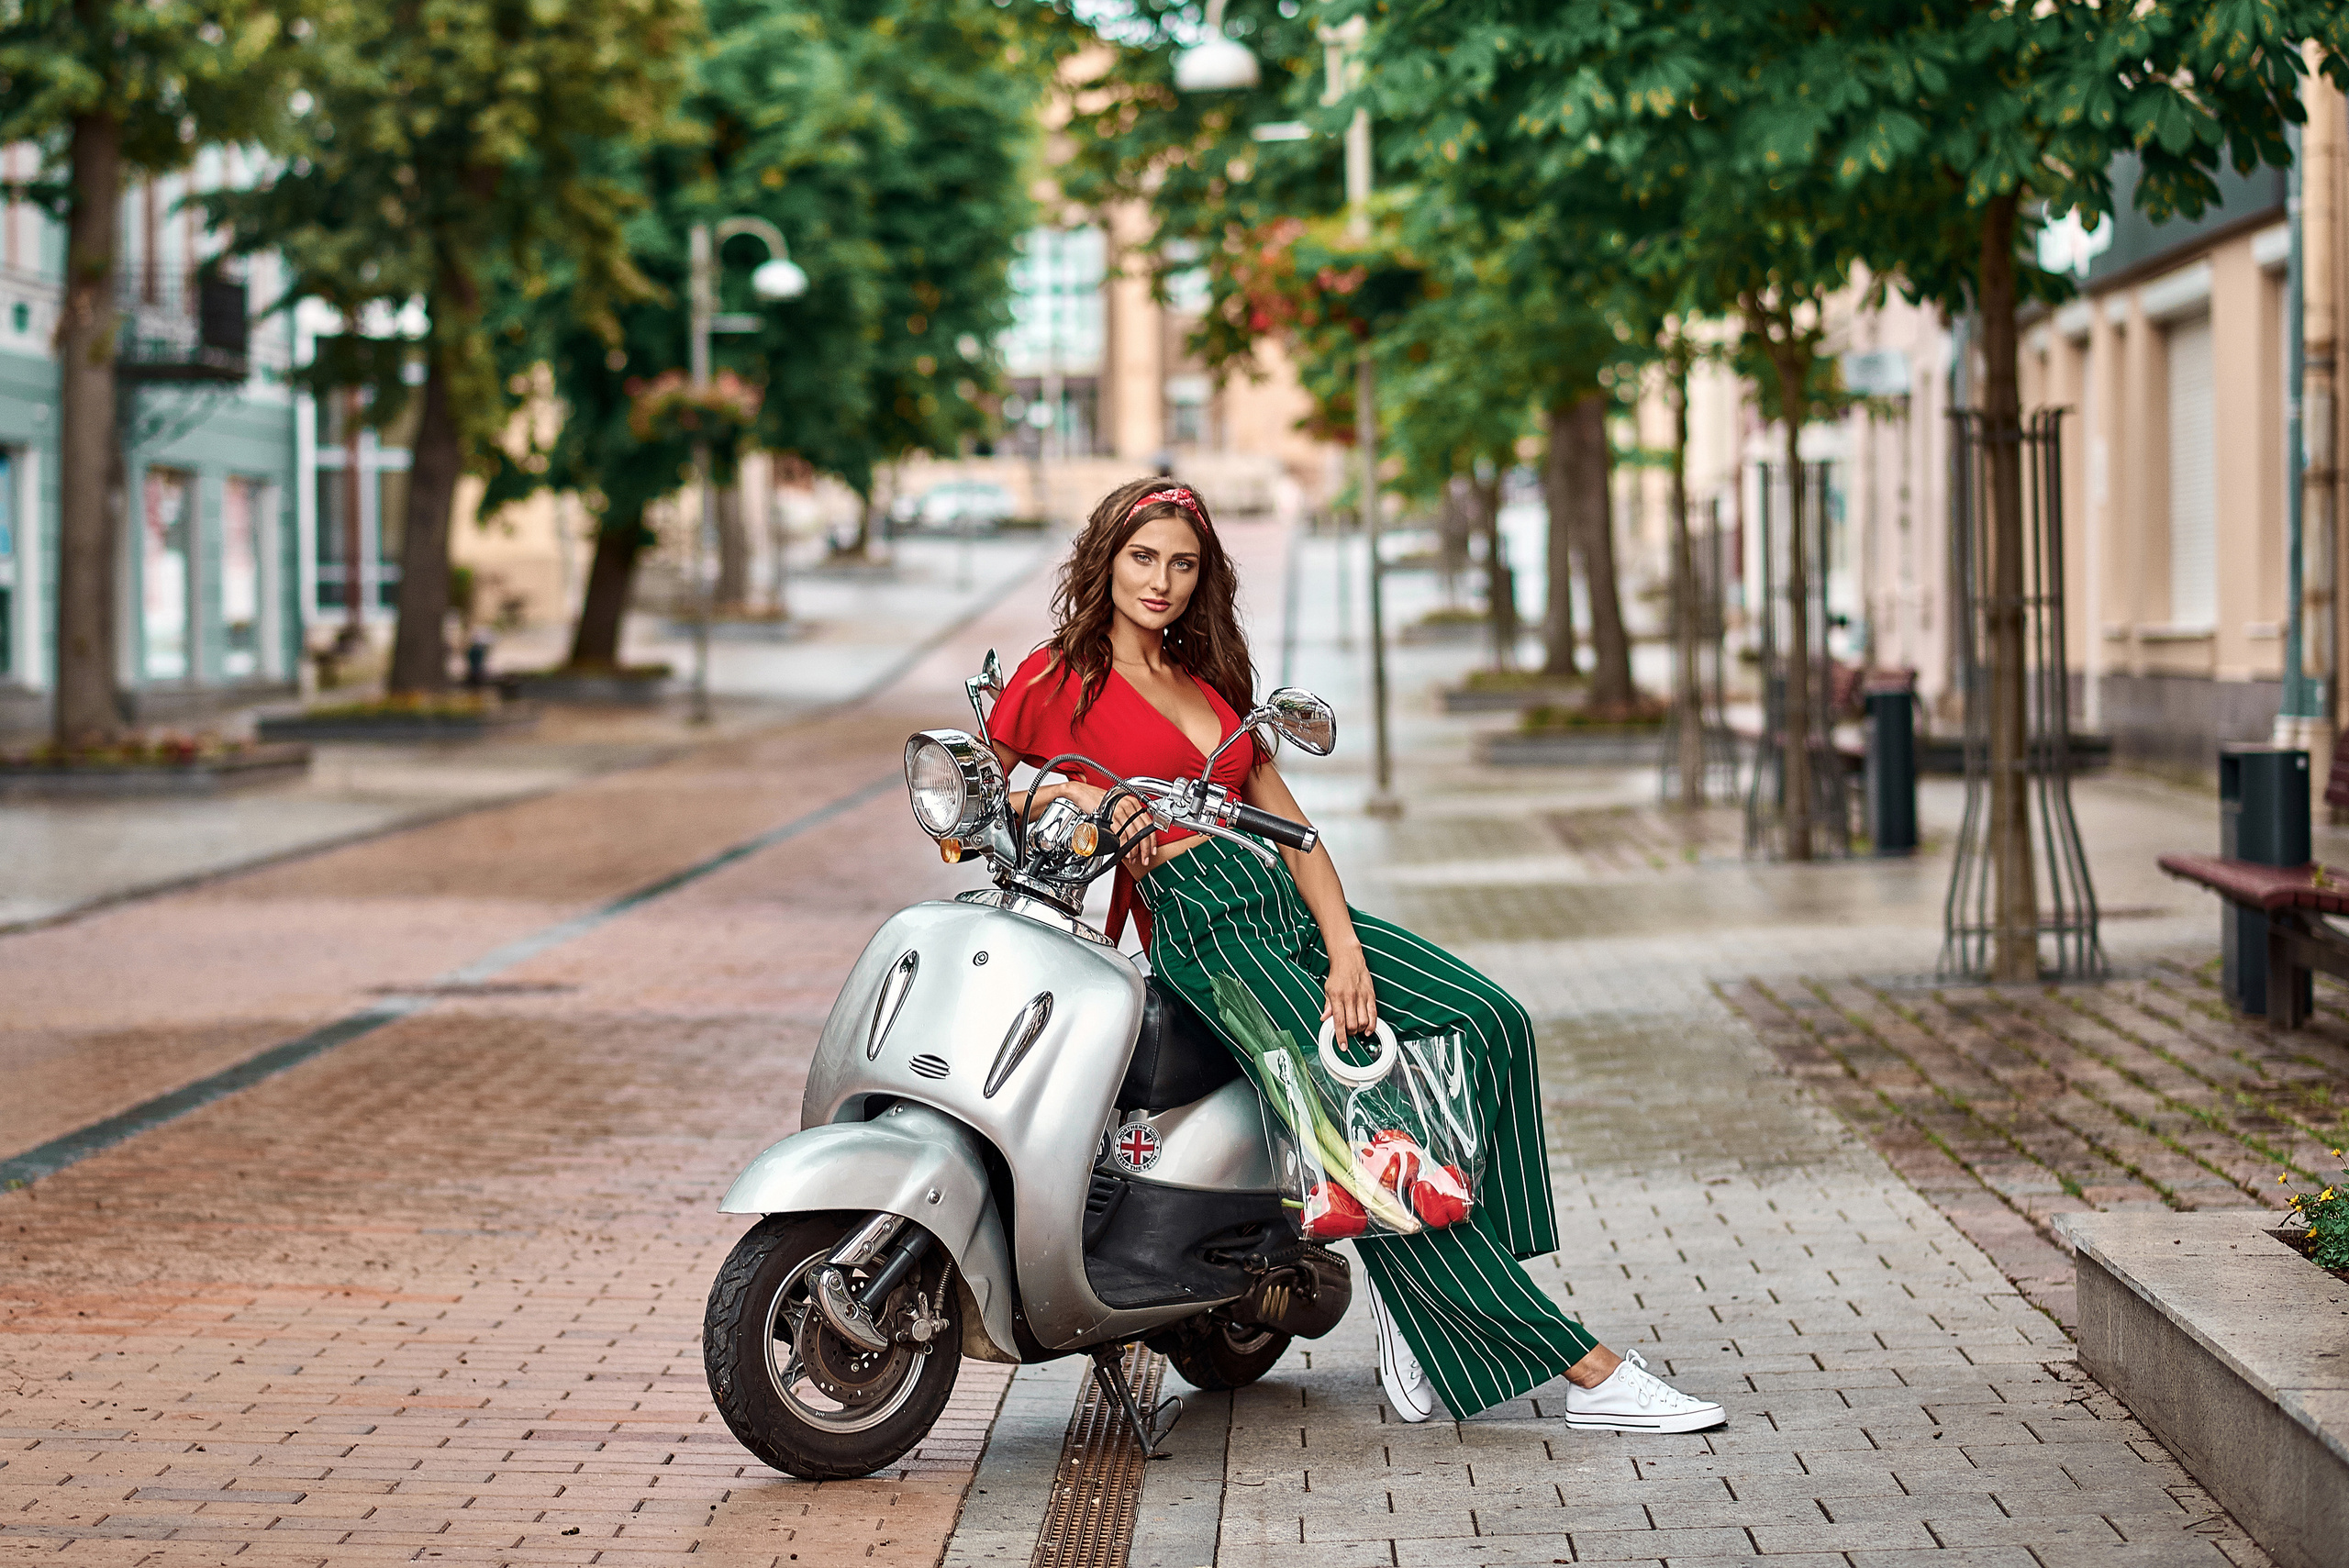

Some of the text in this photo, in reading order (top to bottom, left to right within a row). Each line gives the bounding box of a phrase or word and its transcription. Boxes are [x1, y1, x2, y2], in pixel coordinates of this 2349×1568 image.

[1118, 1125, 1159, 1142] NORTHERN SOUL
[1118, 1153, 1130, 1167] KEEP
[1143, 1155, 1157, 1169] FAITH
